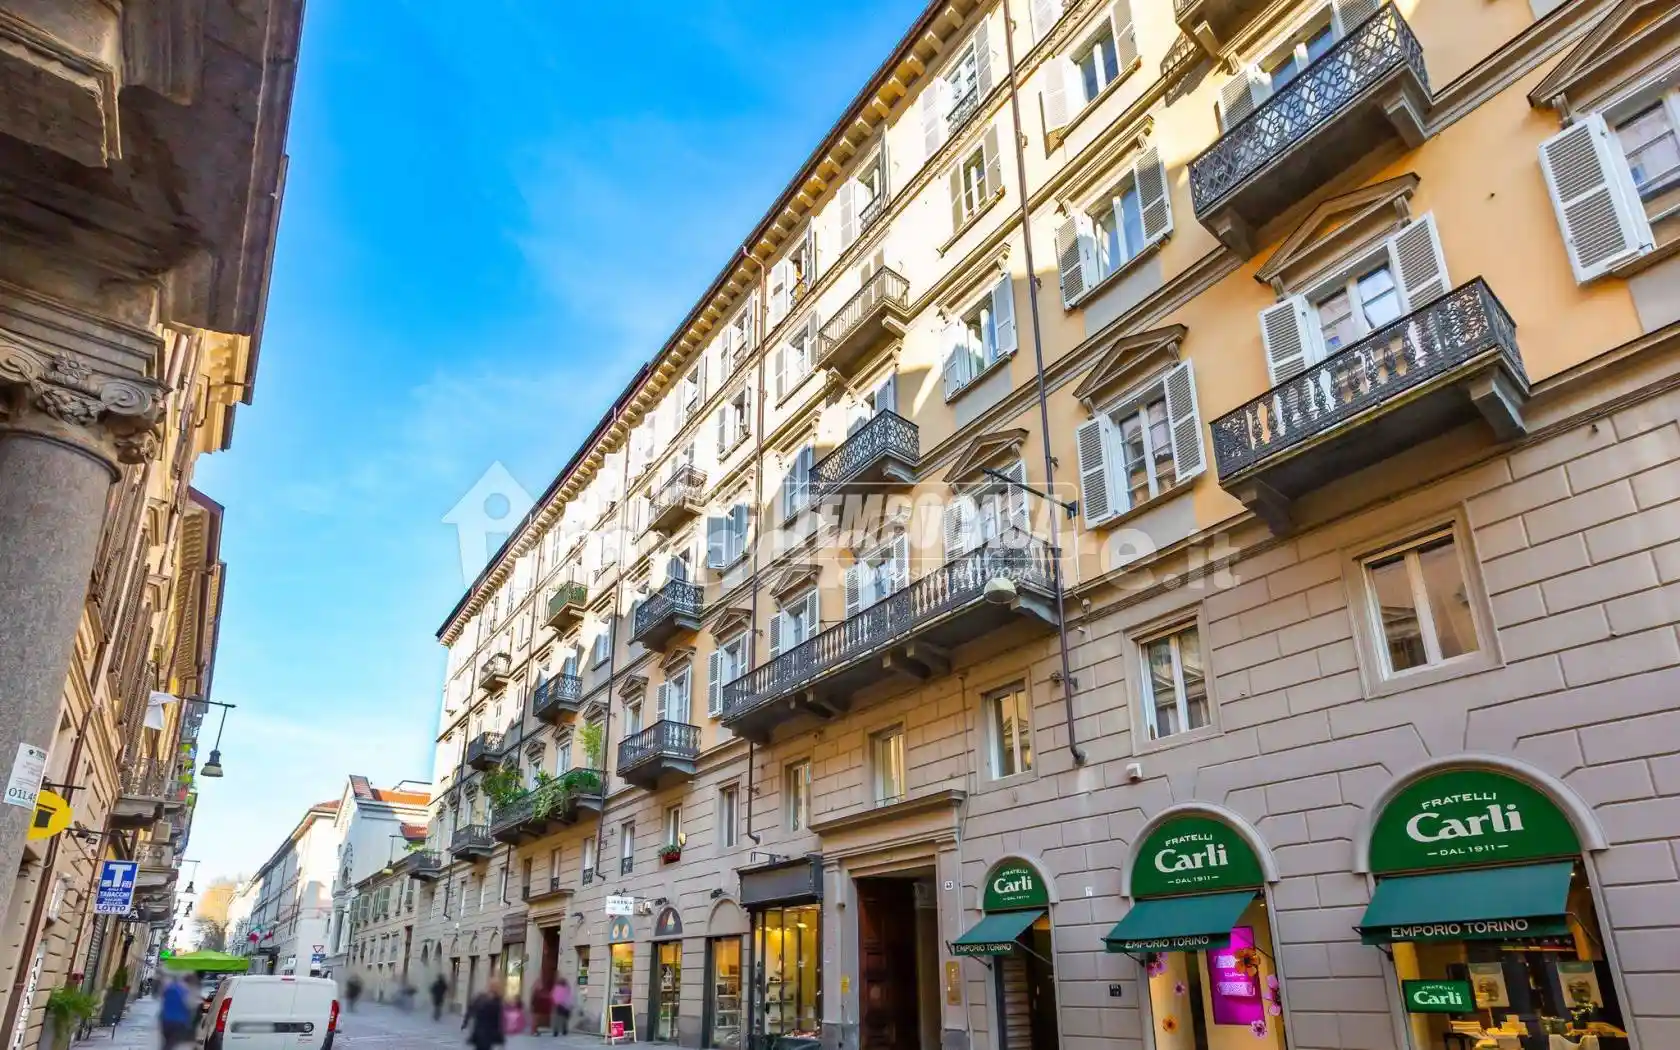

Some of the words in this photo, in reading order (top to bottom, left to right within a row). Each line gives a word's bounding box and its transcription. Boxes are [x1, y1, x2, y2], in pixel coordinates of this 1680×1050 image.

[1421, 792, 1497, 810] FRATELLI
[1406, 803, 1525, 843] Carli
[1165, 833, 1213, 847] FRATELLI
[1468, 844, 1495, 852] 1911
[1154, 843, 1229, 873] Carli
[108, 863, 133, 888] T
[1002, 868, 1029, 876] FRATELLI
[993, 876, 1033, 894] Carli
[96, 904, 126, 912] LOTTO
[1391, 924, 1461, 938] EMPORIO
[1463, 919, 1529, 934] TORINO
[987, 943, 1012, 951] TORINO
[1125, 939, 1170, 949] EMPORIO
[1172, 936, 1209, 947] TORINO
[1413, 990, 1463, 1005] Carli
